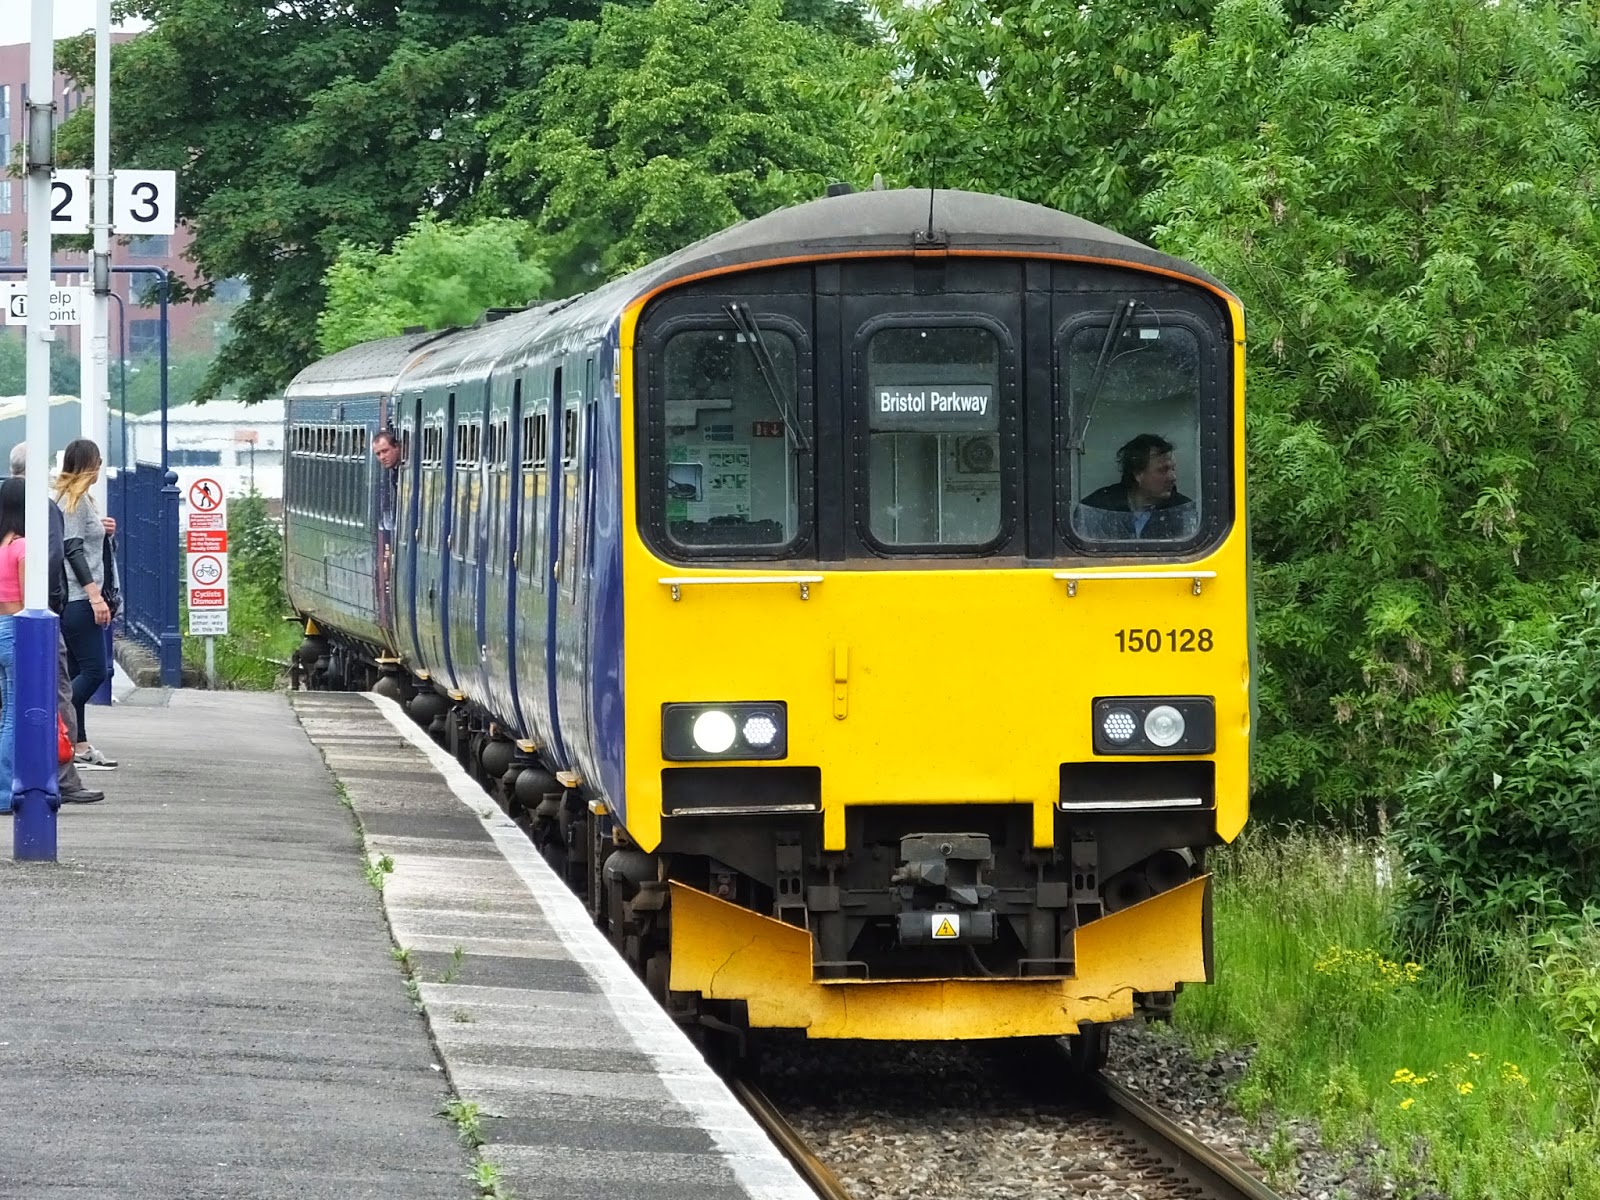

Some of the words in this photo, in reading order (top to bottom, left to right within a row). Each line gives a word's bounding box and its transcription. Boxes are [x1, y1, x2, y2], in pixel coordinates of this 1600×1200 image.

[51, 182, 73, 221] 2
[129, 181, 160, 223] 3
[50, 290, 72, 307] elp
[50, 307, 77, 321] oint
[880, 391, 926, 413] Bristol
[930, 391, 988, 416] Parkway
[192, 597, 223, 605] Dismount
[194, 590, 222, 599] Cyclists
[1114, 628, 1214, 653] 150128
